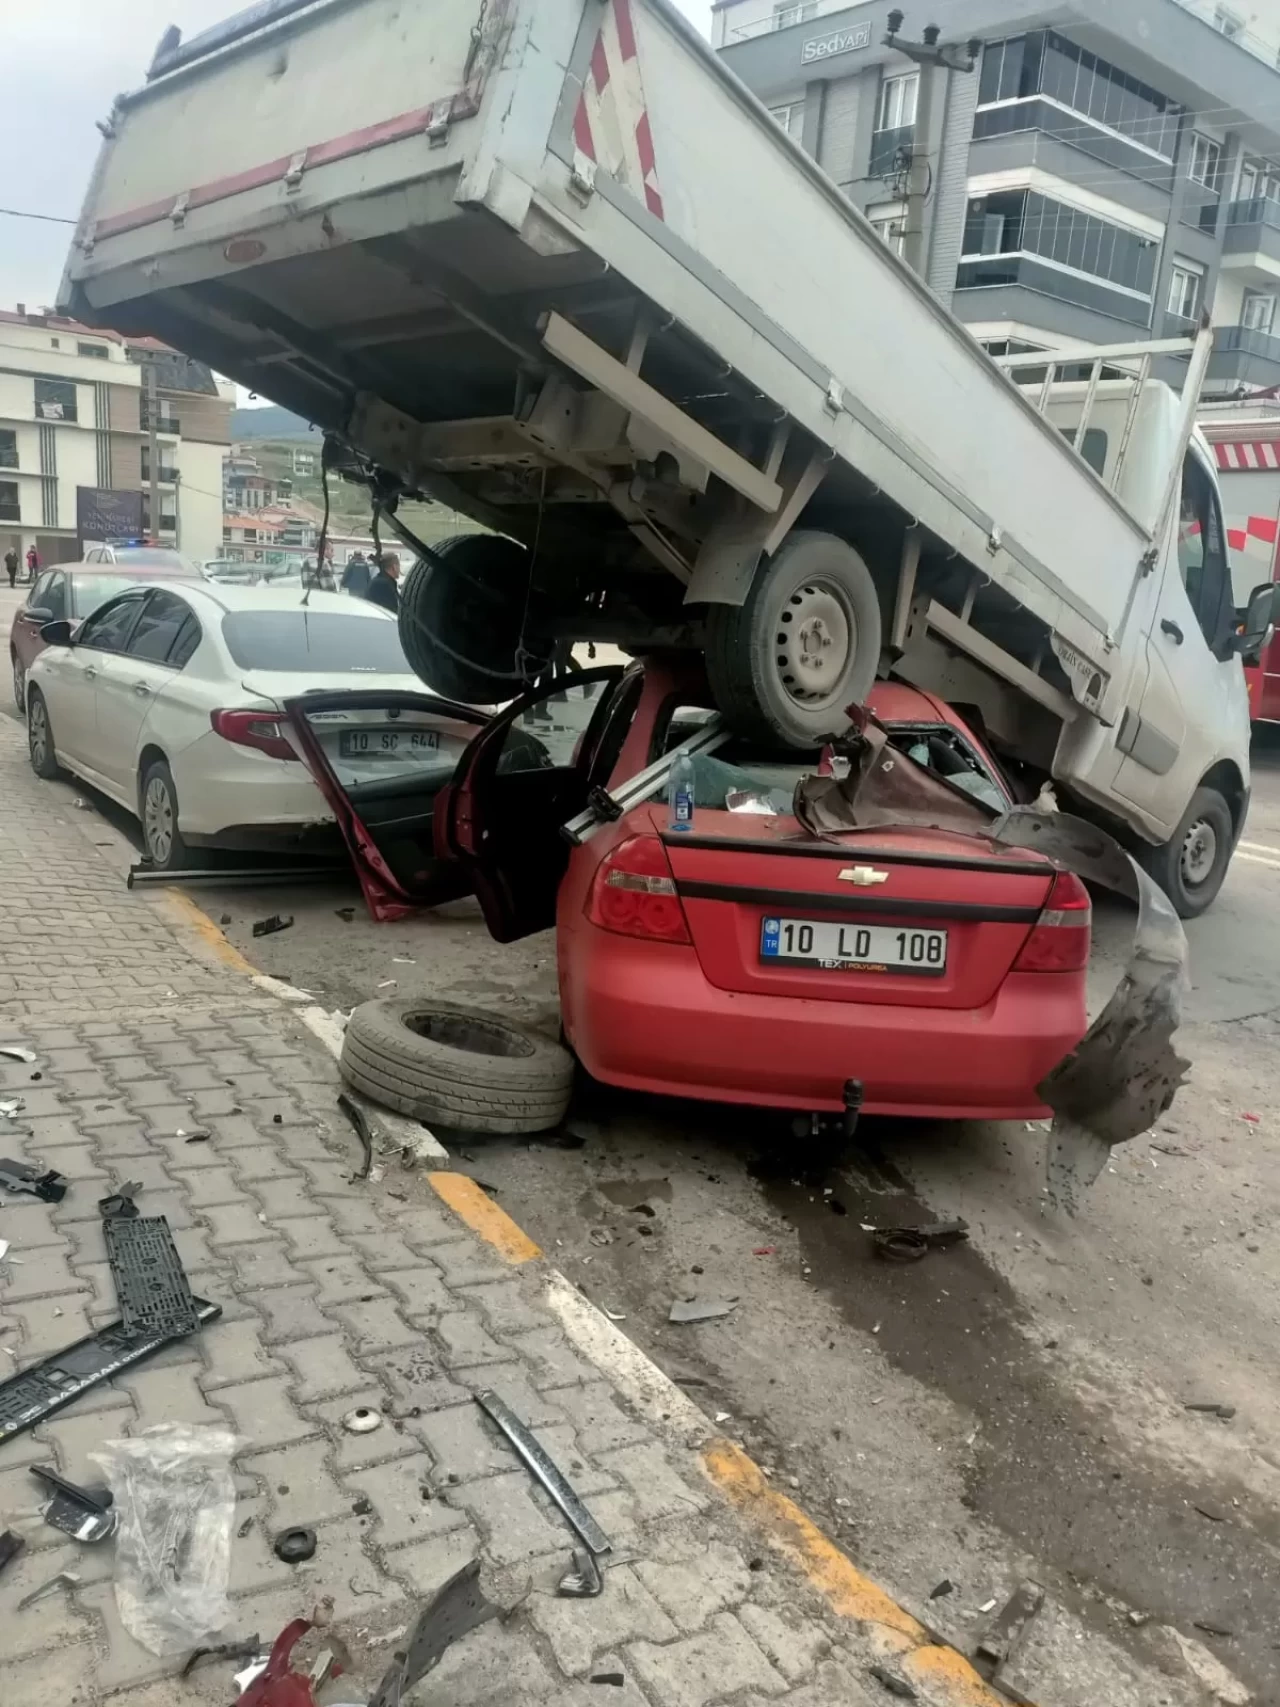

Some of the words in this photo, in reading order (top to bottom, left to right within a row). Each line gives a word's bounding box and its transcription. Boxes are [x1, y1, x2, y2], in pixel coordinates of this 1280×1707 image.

[352, 733, 368, 750] 10
[766, 939, 777, 949] TR
[784, 923, 814, 954] 10
[838, 927, 871, 958] LD
[896, 932, 942, 963] 108
